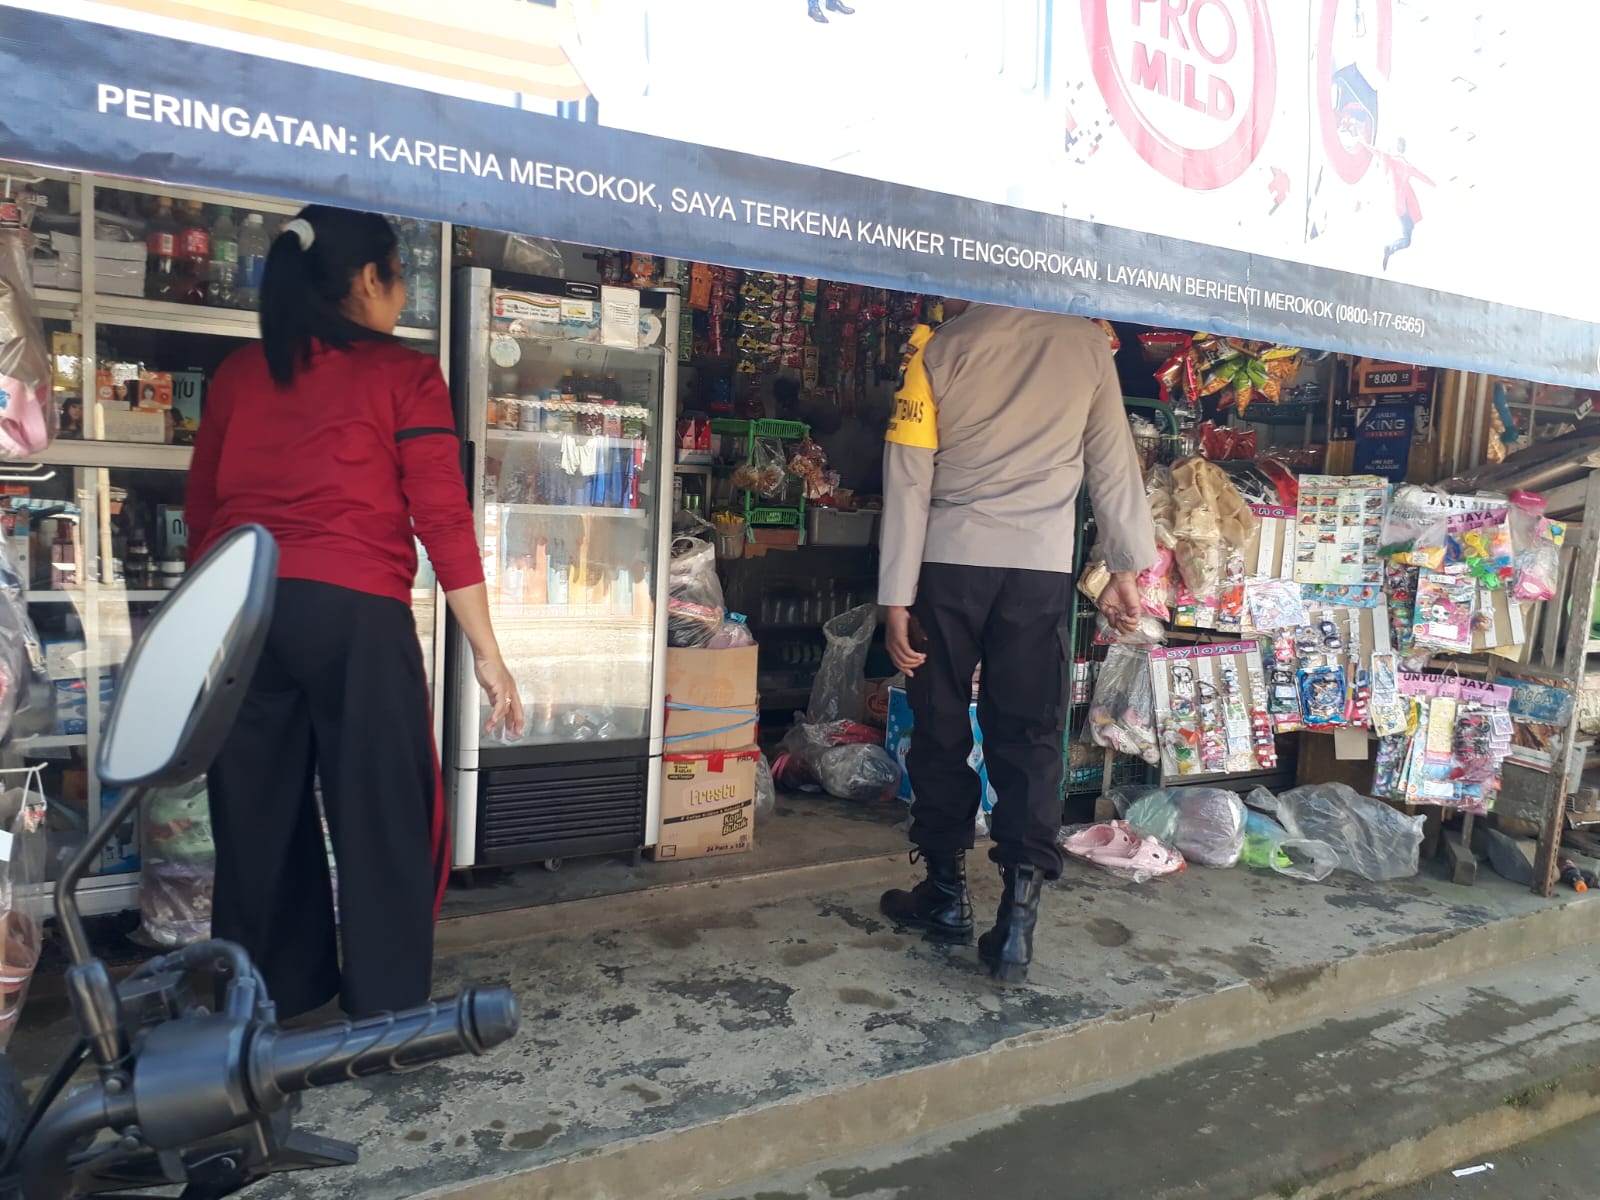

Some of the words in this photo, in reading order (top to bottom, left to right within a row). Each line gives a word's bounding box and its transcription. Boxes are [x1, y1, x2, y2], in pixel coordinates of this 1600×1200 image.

[1130, 40, 1236, 121] MILD
[97, 82, 358, 157] PERINGATAN:
[368, 131, 505, 182] KARENA
[510, 157, 664, 214] MEROKOK,
[670, 187, 738, 222] SAYA
[740, 199, 854, 242] TERKENA
[857, 219, 946, 256] KANKER
[949, 235, 1103, 282] TENGGOROKAN.
[1107, 262, 1183, 294] LAYANAN
[1185, 276, 1262, 310] BERHENTI
[1263, 289, 1335, 319] MEROKOK
[1335, 302, 1426, 339] (0800-177-6565)
[1403, 673, 1456, 685] UNTUNG
[1460, 679, 1495, 691] JAYA
